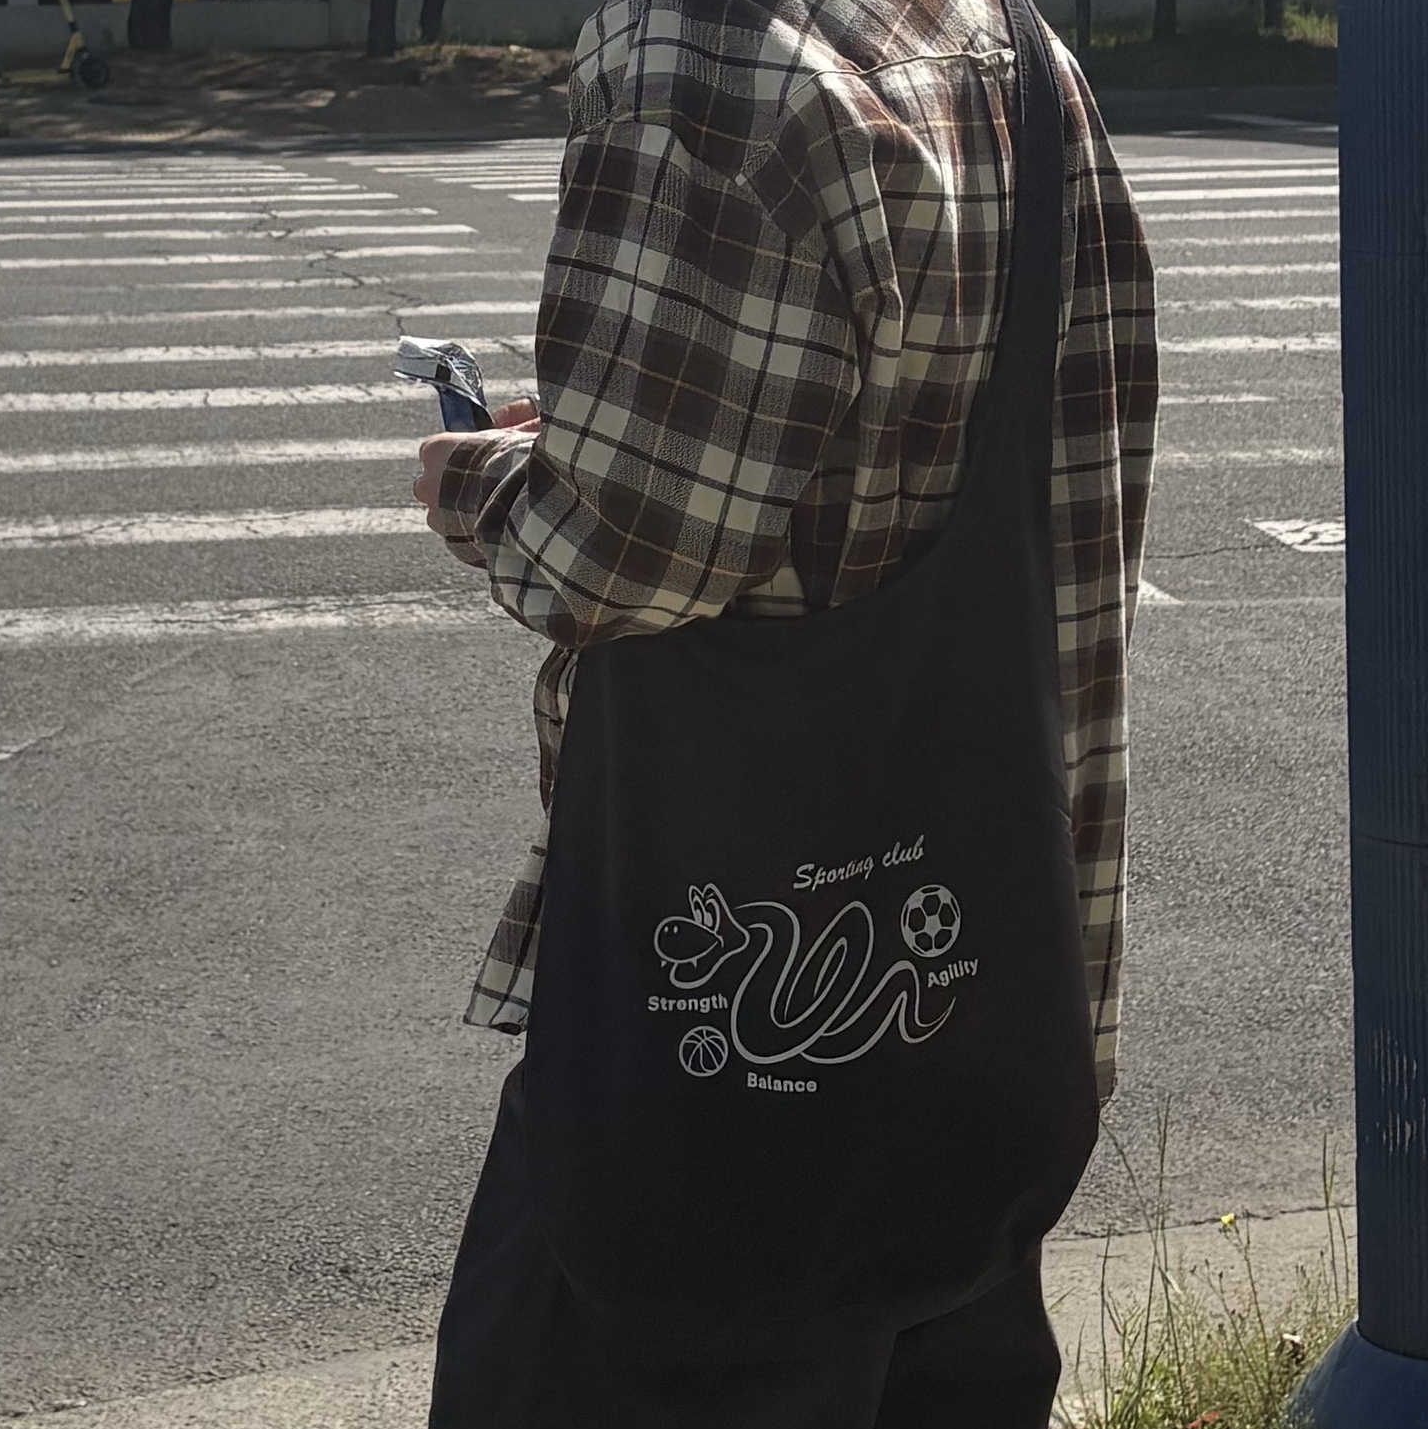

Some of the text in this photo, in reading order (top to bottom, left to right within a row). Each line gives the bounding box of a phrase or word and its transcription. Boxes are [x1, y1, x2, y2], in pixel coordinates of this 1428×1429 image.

[792, 834, 926, 892] Sporting club
[926, 956, 980, 989] Agility
[647, 992, 729, 1014] Strength
[746, 1071, 818, 1094] Balance
